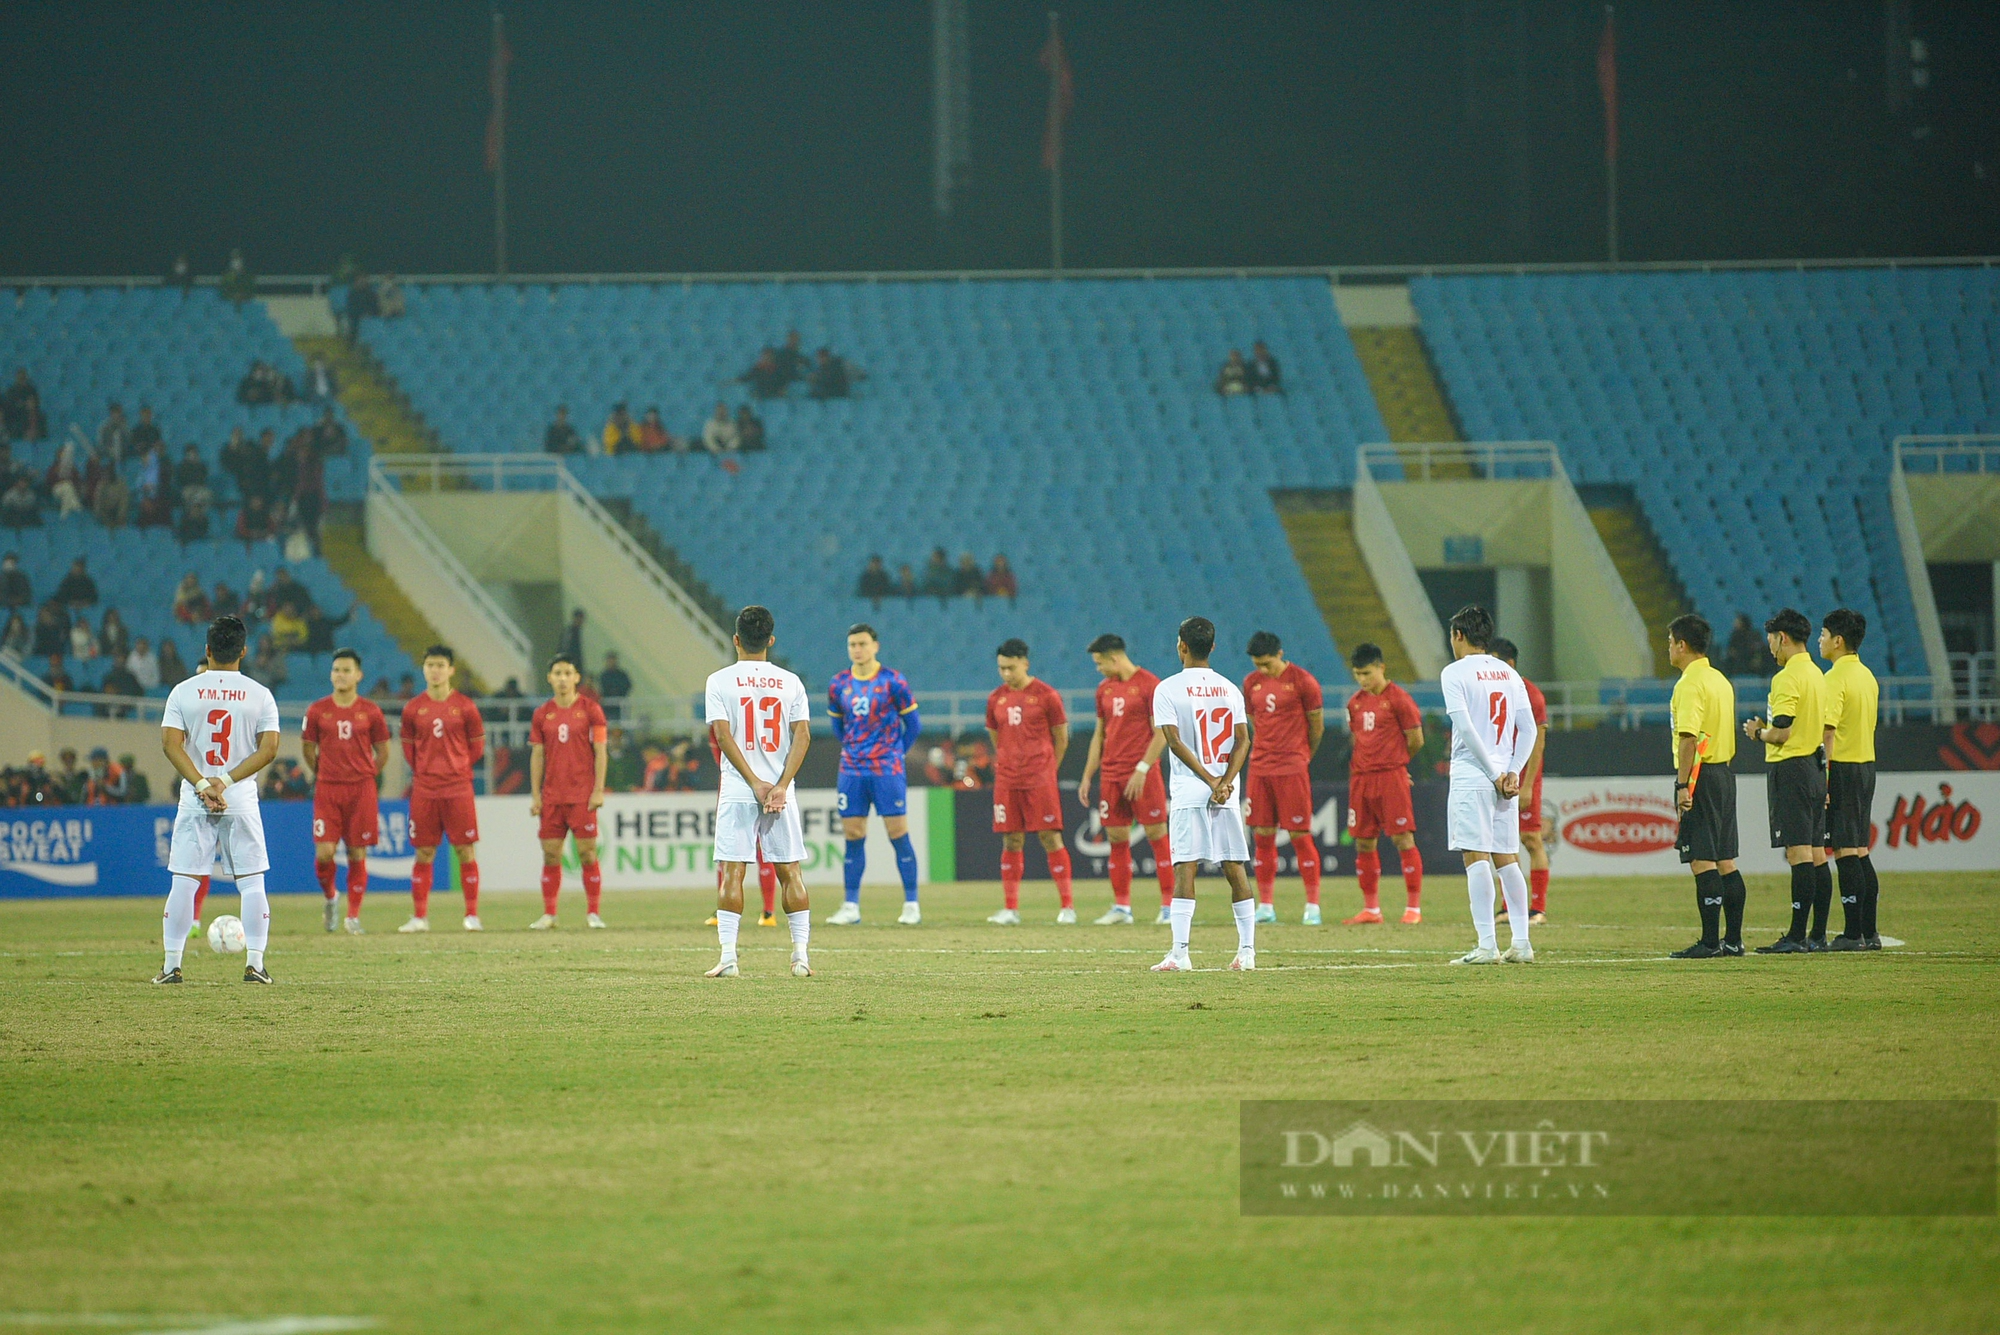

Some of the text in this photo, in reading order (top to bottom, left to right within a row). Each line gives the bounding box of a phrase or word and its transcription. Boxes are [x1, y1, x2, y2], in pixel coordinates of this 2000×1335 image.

[736, 677, 784, 690] L.H.SOE
[197, 688, 246, 701] Y.M.THU
[1007, 705, 1022, 726] 16
[1112, 697, 1126, 717] 12
[432, 717, 444, 739] 2
[739, 696, 782, 753] 13
[1362, 711, 1376, 732] 18
[1489, 692, 1508, 745] 9
[206, 709, 233, 767] 3
[336, 720, 352, 741] 13
[558, 723, 569, 743] 8
[1195, 707, 1233, 765] 12
